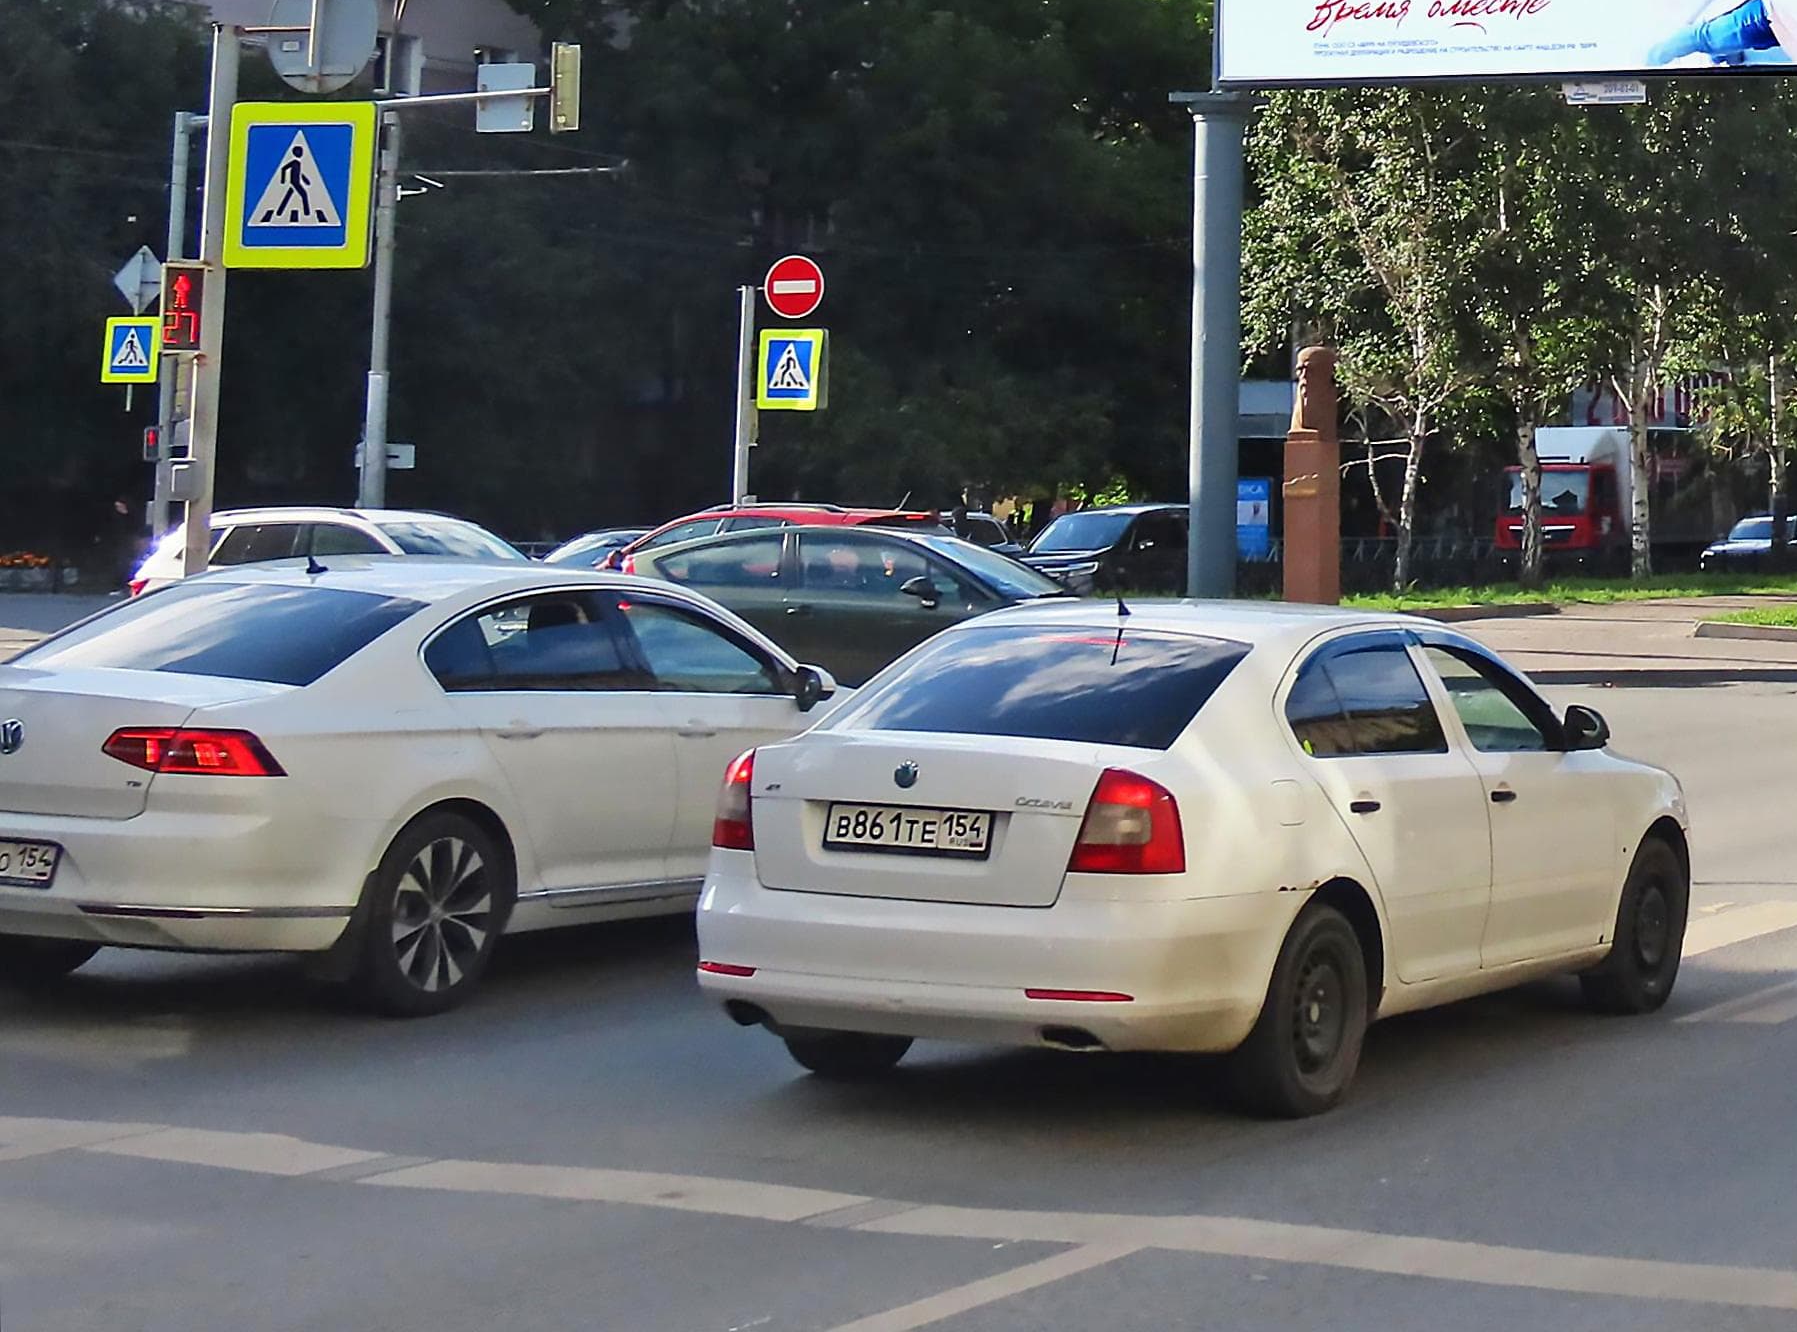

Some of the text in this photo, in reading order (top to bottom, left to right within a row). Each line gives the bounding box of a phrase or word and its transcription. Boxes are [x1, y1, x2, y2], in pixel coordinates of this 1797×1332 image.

[162, 311, 199, 344] 27
[836, 810, 984, 844] В861ТЕ 154
[17, 847, 52, 867] 154
